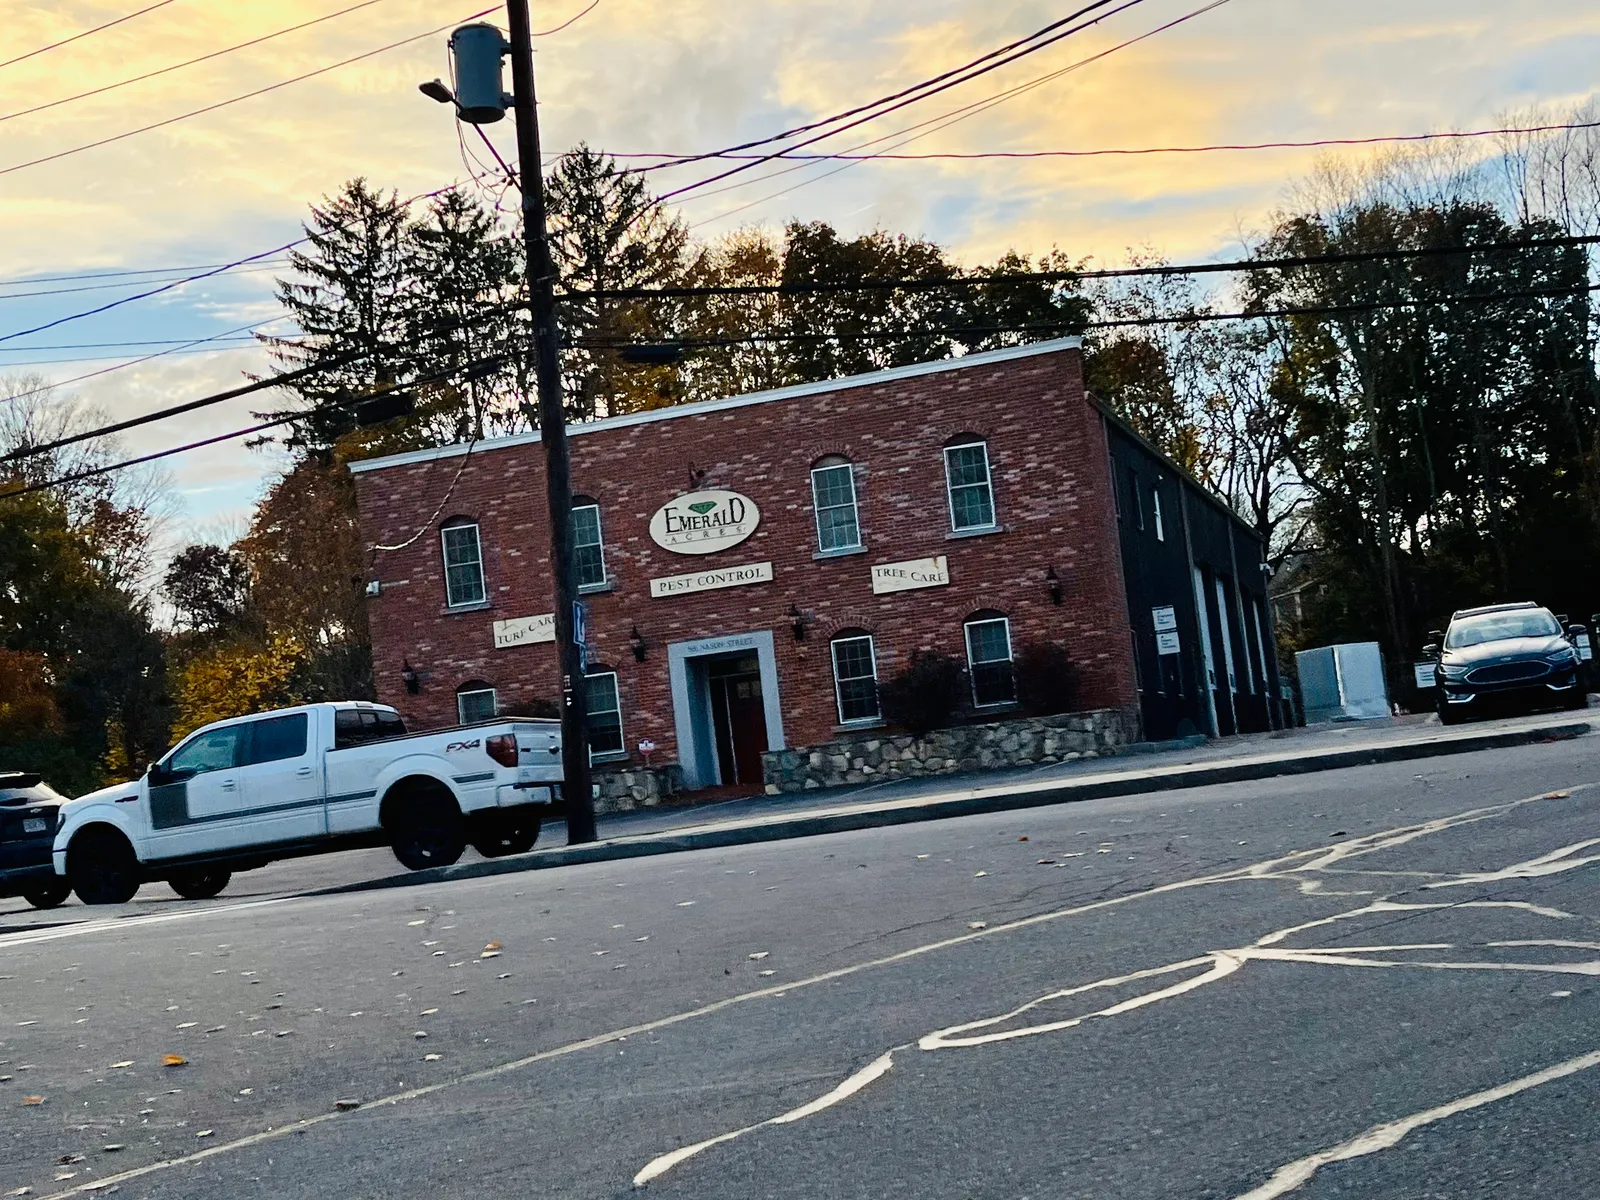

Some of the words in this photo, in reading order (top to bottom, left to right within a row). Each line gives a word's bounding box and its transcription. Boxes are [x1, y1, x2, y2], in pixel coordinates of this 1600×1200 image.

[659, 578, 692, 592] PEST
[697, 568, 764, 586] CONTROL
[875, 568, 907, 578] TREE
[911, 572, 946, 582] CARE
[498, 628, 527, 644] TURF
[727, 637, 753, 647] STREET
[446, 739, 480, 752] FX4
